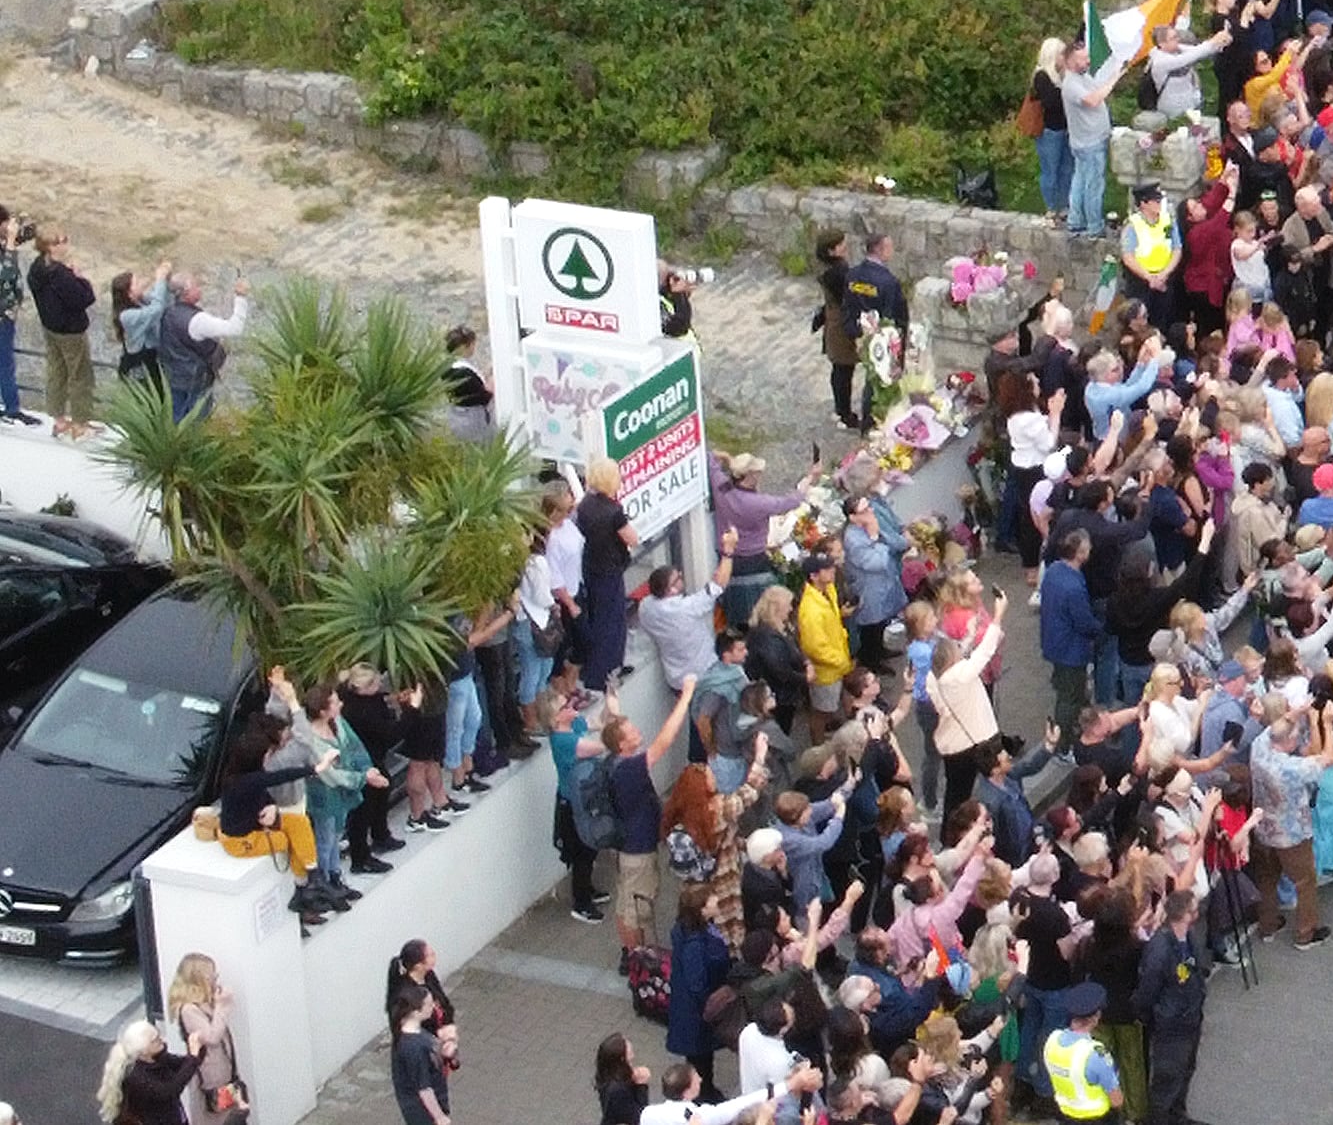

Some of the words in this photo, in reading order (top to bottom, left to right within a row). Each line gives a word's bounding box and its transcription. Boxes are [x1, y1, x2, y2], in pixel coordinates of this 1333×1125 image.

[547, 306, 618, 330] SPAR
[613, 376, 689, 441] Coonan
[620, 452, 647, 475] UST
[648, 444, 657, 459] 2
[657, 418, 695, 450] UNITS
[627, 489, 653, 520] OR
[657, 455, 699, 502] SALE
